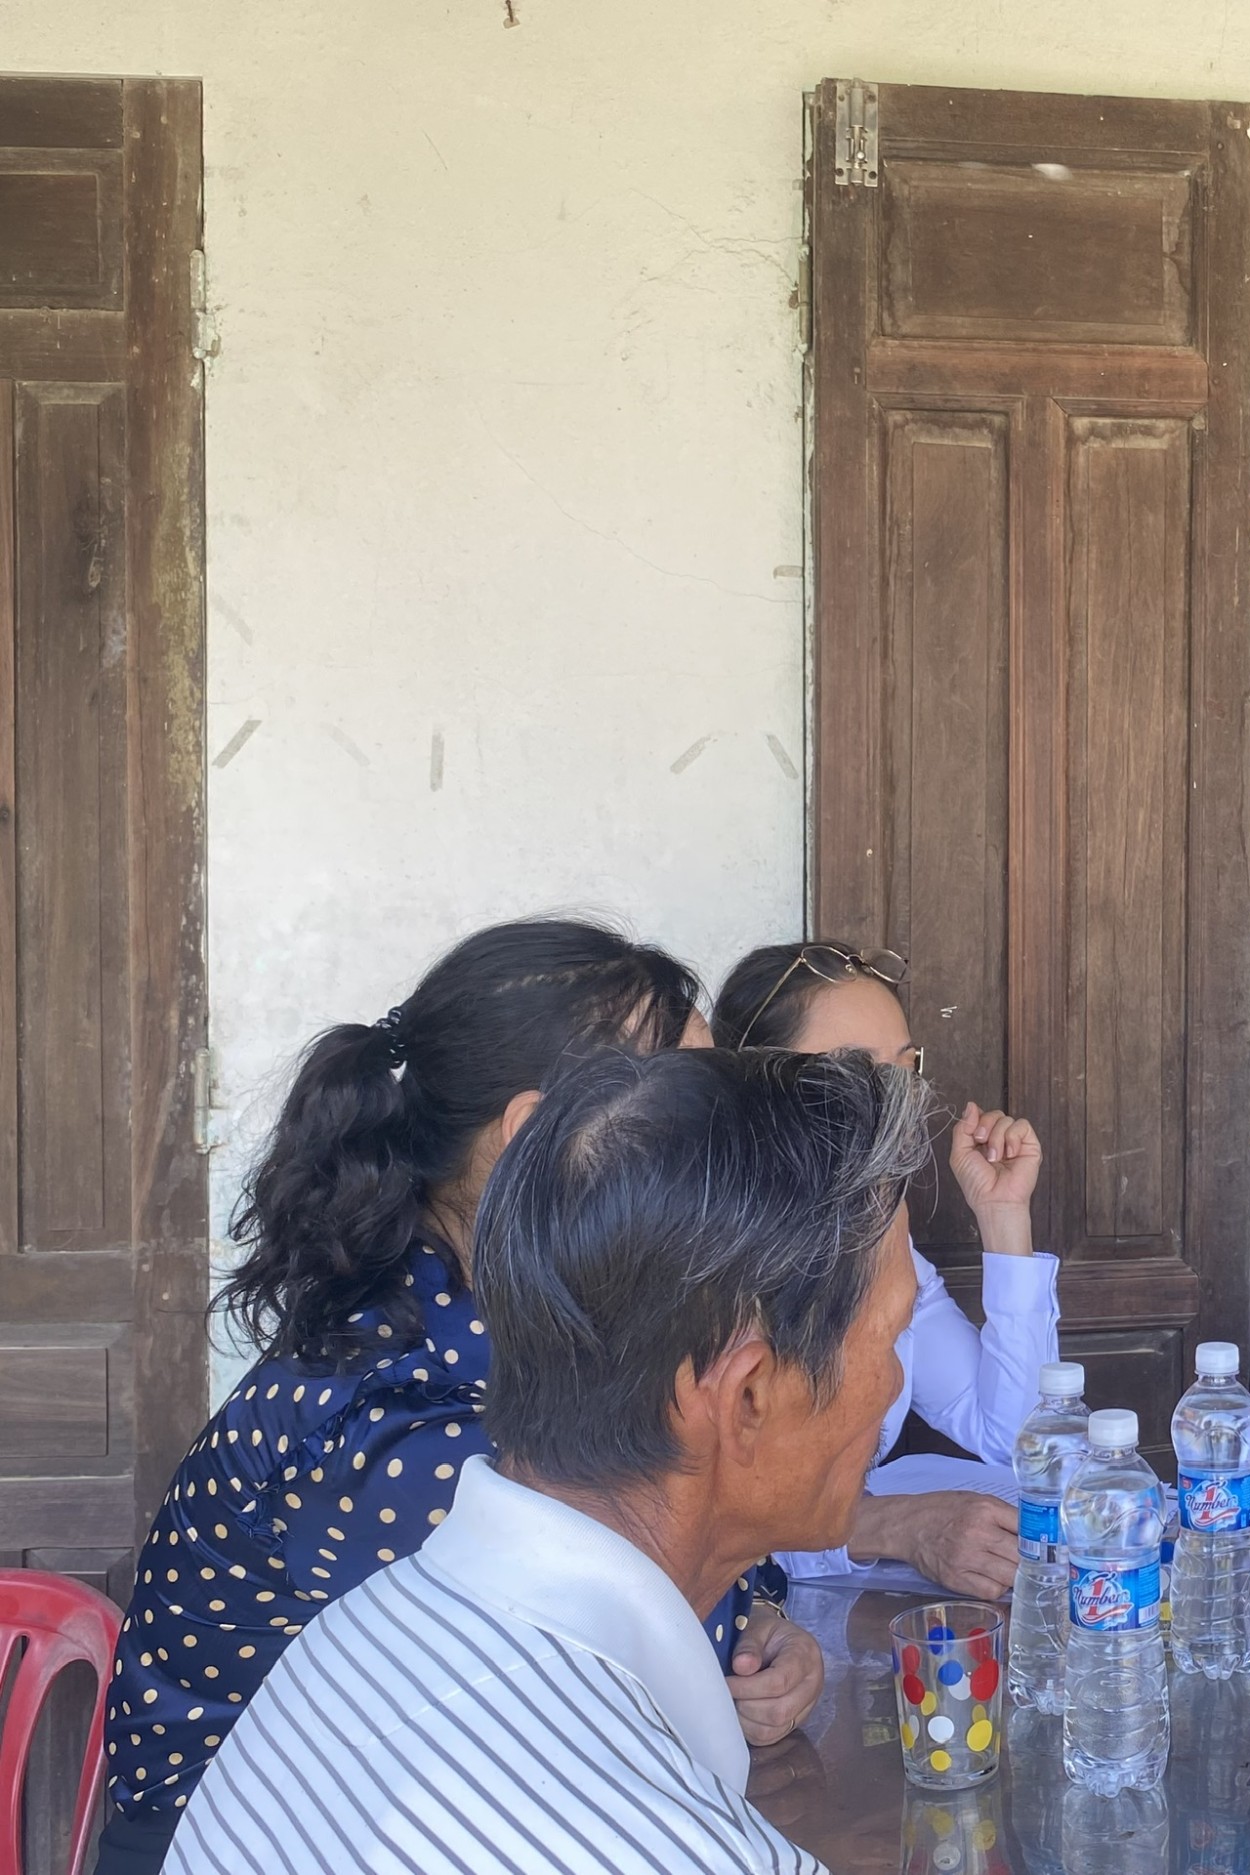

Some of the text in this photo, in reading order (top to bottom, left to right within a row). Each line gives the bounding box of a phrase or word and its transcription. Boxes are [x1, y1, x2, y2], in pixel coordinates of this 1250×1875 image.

[1186, 1492, 1234, 1511] Number
[1200, 1486, 1216, 1520] 1
[1074, 1586, 1125, 1606] Number
[1086, 1579, 1104, 1616] 1
